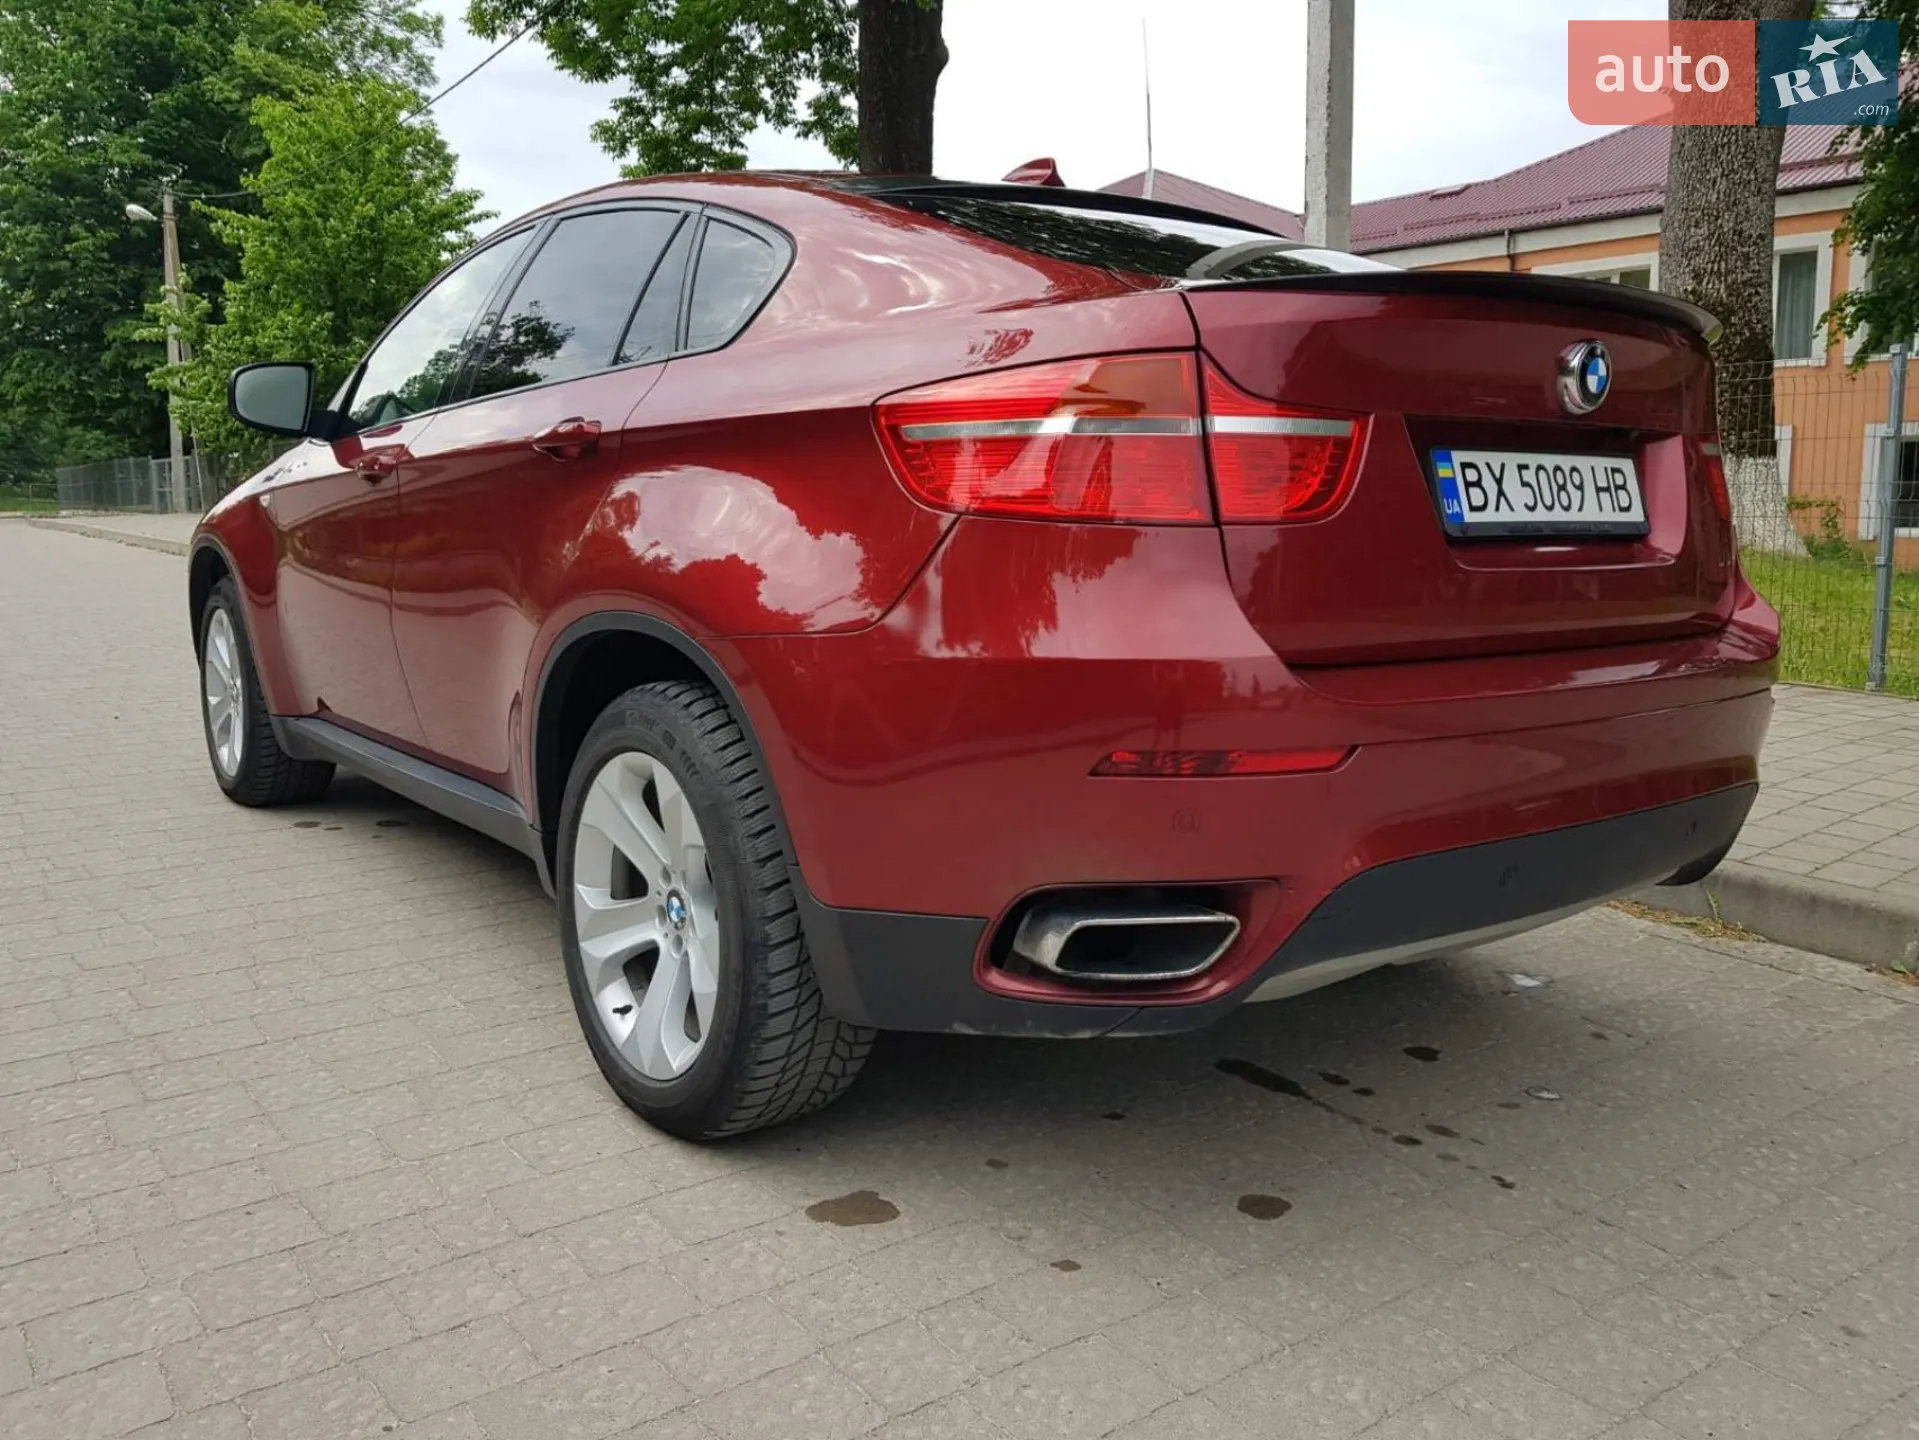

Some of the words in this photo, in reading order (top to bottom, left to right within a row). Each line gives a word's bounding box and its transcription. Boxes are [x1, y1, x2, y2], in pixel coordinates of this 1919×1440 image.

[1460, 462, 1515, 513] BX
[1517, 463, 1585, 513] 5089
[1590, 465, 1632, 513] HB
[1444, 498, 1461, 514] UA
